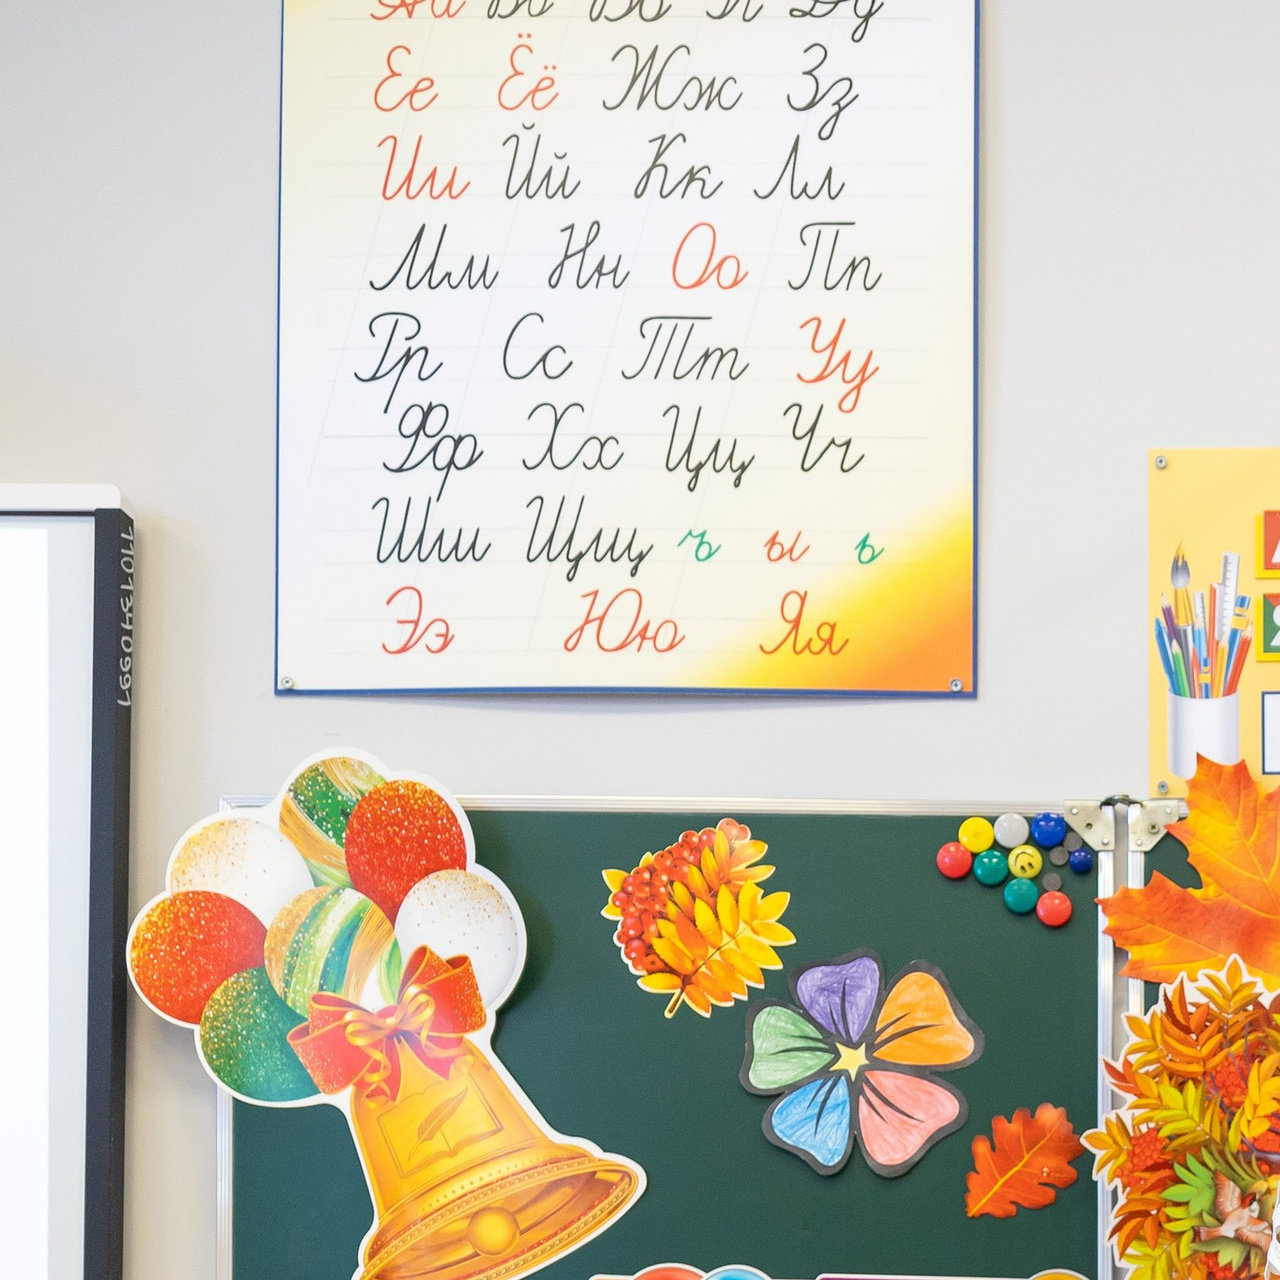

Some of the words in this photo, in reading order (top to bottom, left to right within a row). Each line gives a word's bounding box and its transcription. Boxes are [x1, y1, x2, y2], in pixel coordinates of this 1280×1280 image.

[374, 45, 438, 112] Ее
[498, 33, 559, 110] Ёё
[603, 44, 742, 110] Жж
[787, 43, 858, 140] Зз
[378, 135, 470, 200] Ии
[502, 122, 580, 200] Йй
[634, 133, 723, 199] Кк
[754, 134, 845, 200] Лл
[370, 223, 498, 291] Мм
[548, 221, 629, 289] Нн
[671, 223, 749, 289] Оо
[788, 222, 882, 291] Пп
[354, 312, 443, 414] Рр
[503, 312, 573, 380] Сс
[622, 316, 749, 380] Тт
[797, 317, 879, 413] Уу
[383, 401, 483, 502] Фф
[523, 403, 624, 470] Хх
[663, 405, 755, 492] Цц
[783, 403, 864, 473] Чч
[372, 497, 491, 563] Шш
[526, 496, 653, 582] Щщ
[678, 530, 722, 562] ъ
[763, 531, 810, 562] ы
[855, 533, 884, 564] ь
[382, 586, 455, 655] Ээ
[564, 588, 685, 653] Юю
[759, 590, 849, 656] Яя
